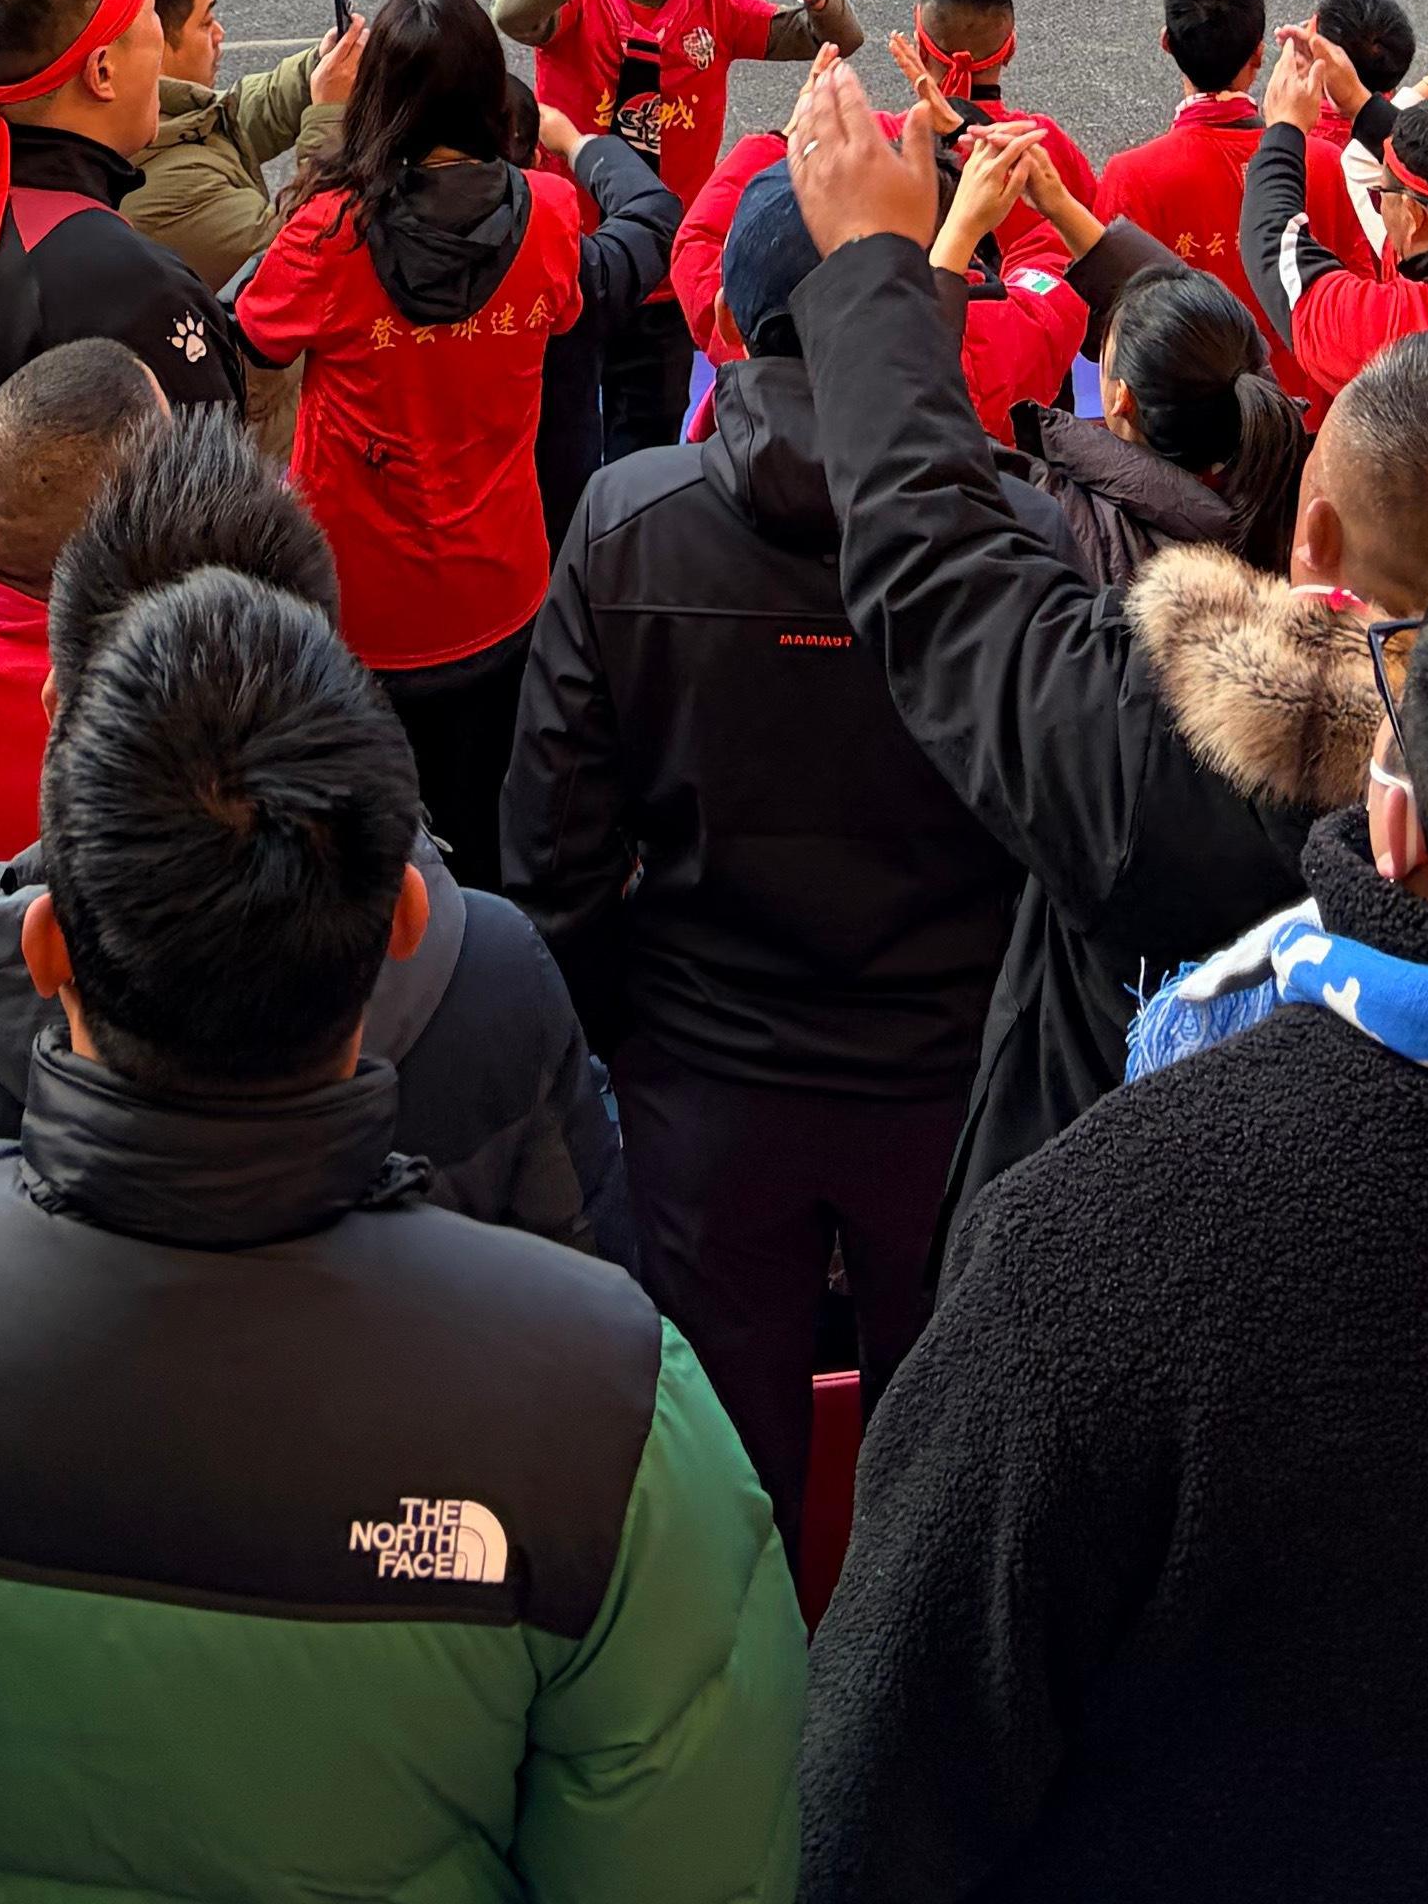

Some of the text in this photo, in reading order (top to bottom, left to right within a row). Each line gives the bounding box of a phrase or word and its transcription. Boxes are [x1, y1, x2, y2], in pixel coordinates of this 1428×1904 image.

[779, 634, 852, 648] MAMMUT
[399, 1497, 462, 1527] THE
[349, 1520, 456, 1553] NORTH
[378, 1550, 454, 1580] FACE
